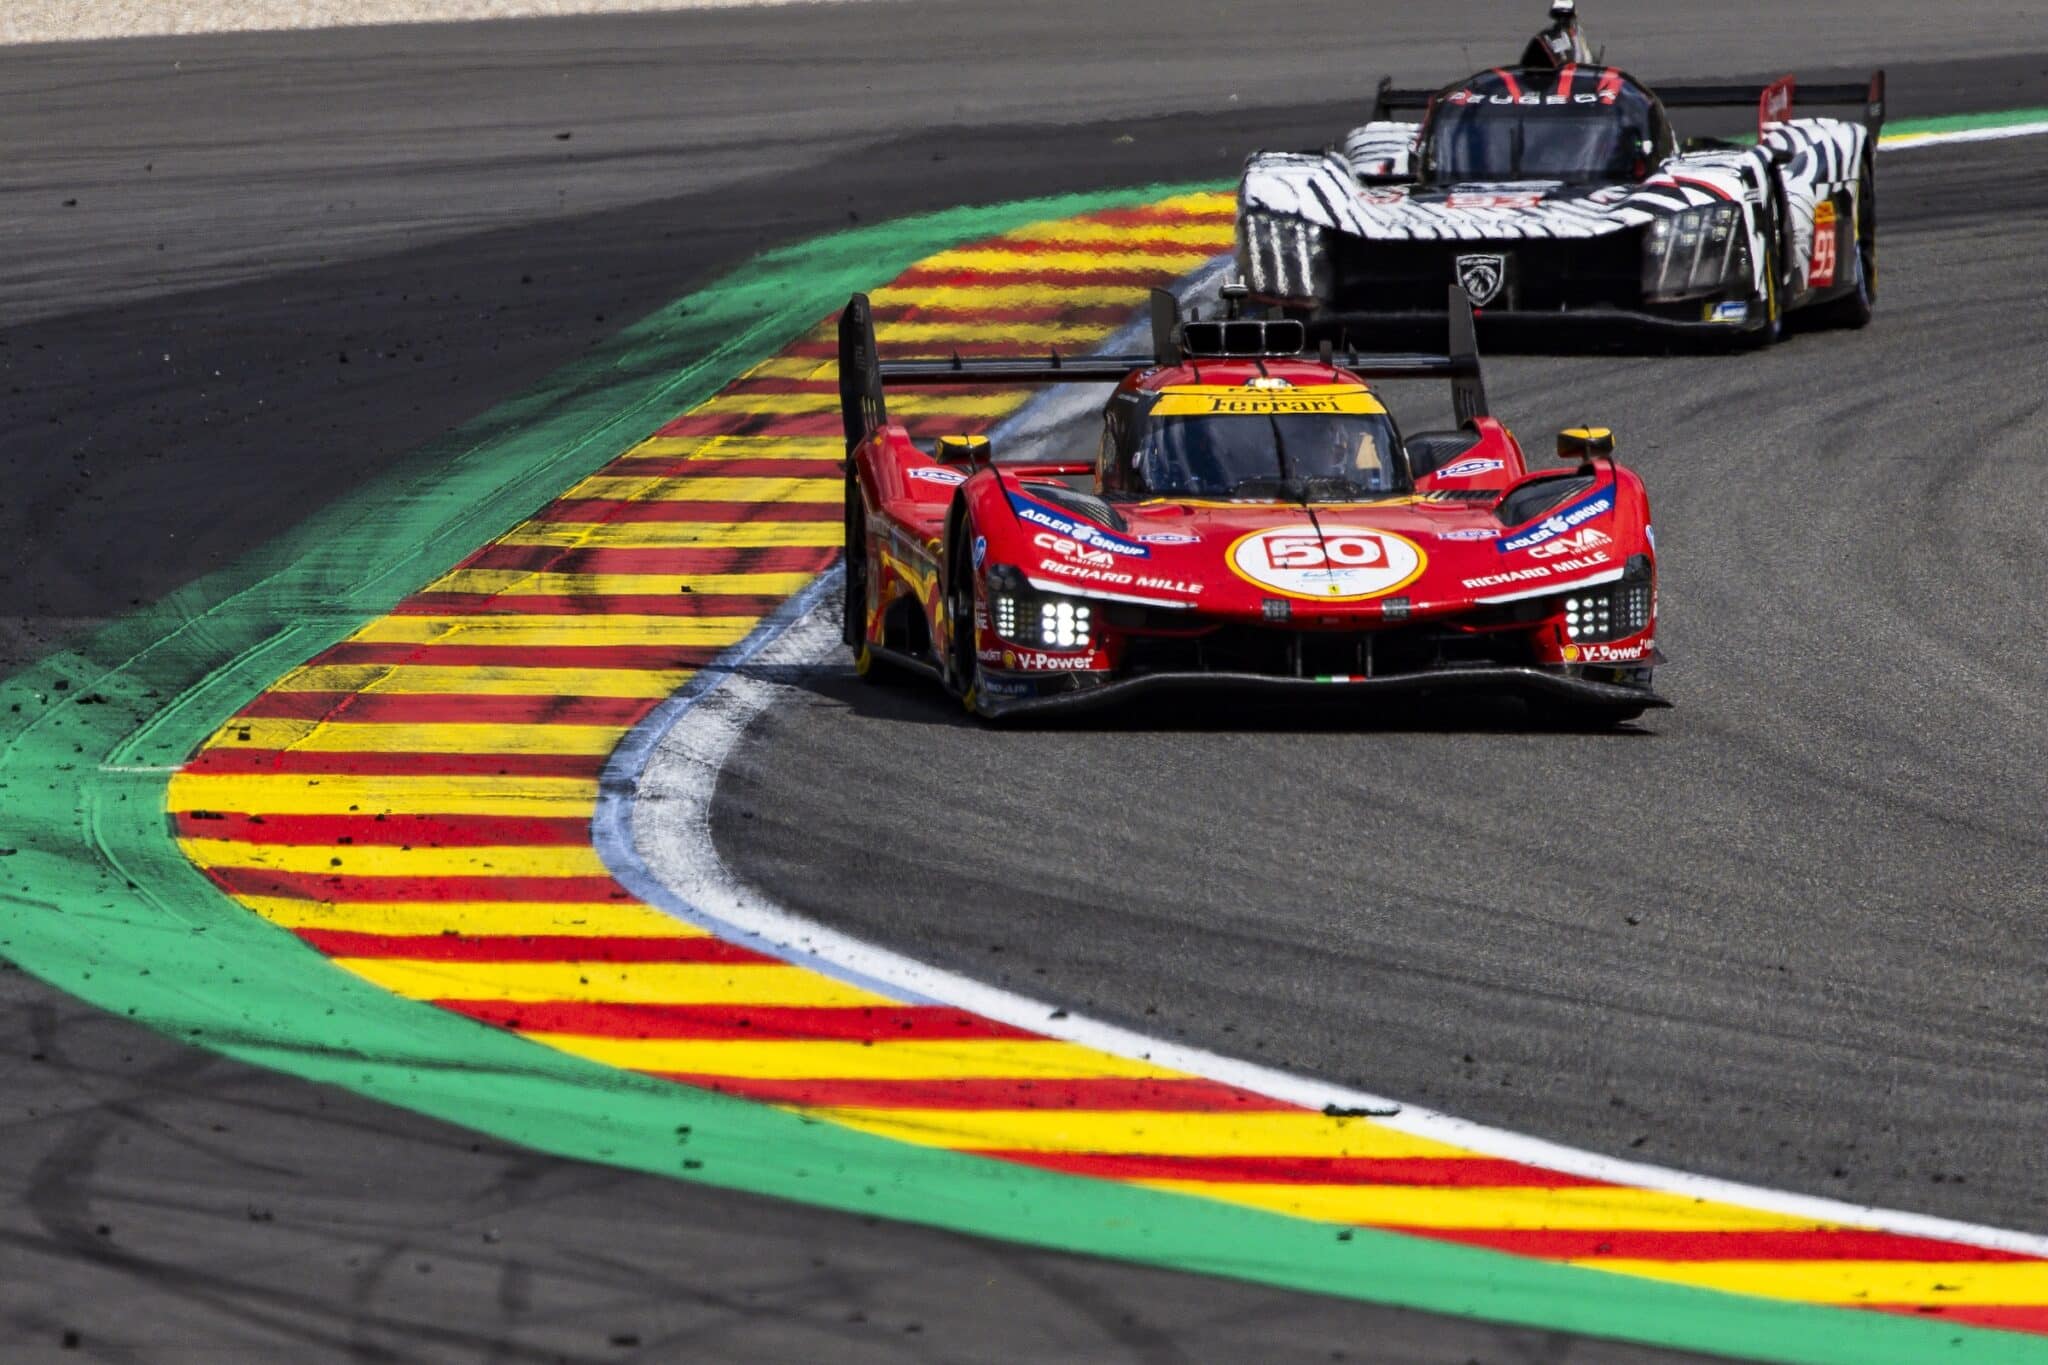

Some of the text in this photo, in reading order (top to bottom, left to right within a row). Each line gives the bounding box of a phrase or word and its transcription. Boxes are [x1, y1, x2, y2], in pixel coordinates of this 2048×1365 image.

[1449, 90, 1617, 105] PEUGEOT
[1209, 396, 1342, 412] Ferrari
[1019, 508, 1146, 556] ADLER GROUP
[1504, 499, 1611, 551] ADLER GROUP
[1269, 537, 1382, 568] 50
[1040, 559, 1204, 594] RICHARD MILLE
[1462, 551, 1610, 589] RICHARD MILLE
[1018, 653, 1094, 669] V-Power
[1583, 645, 1643, 661] V-Power
